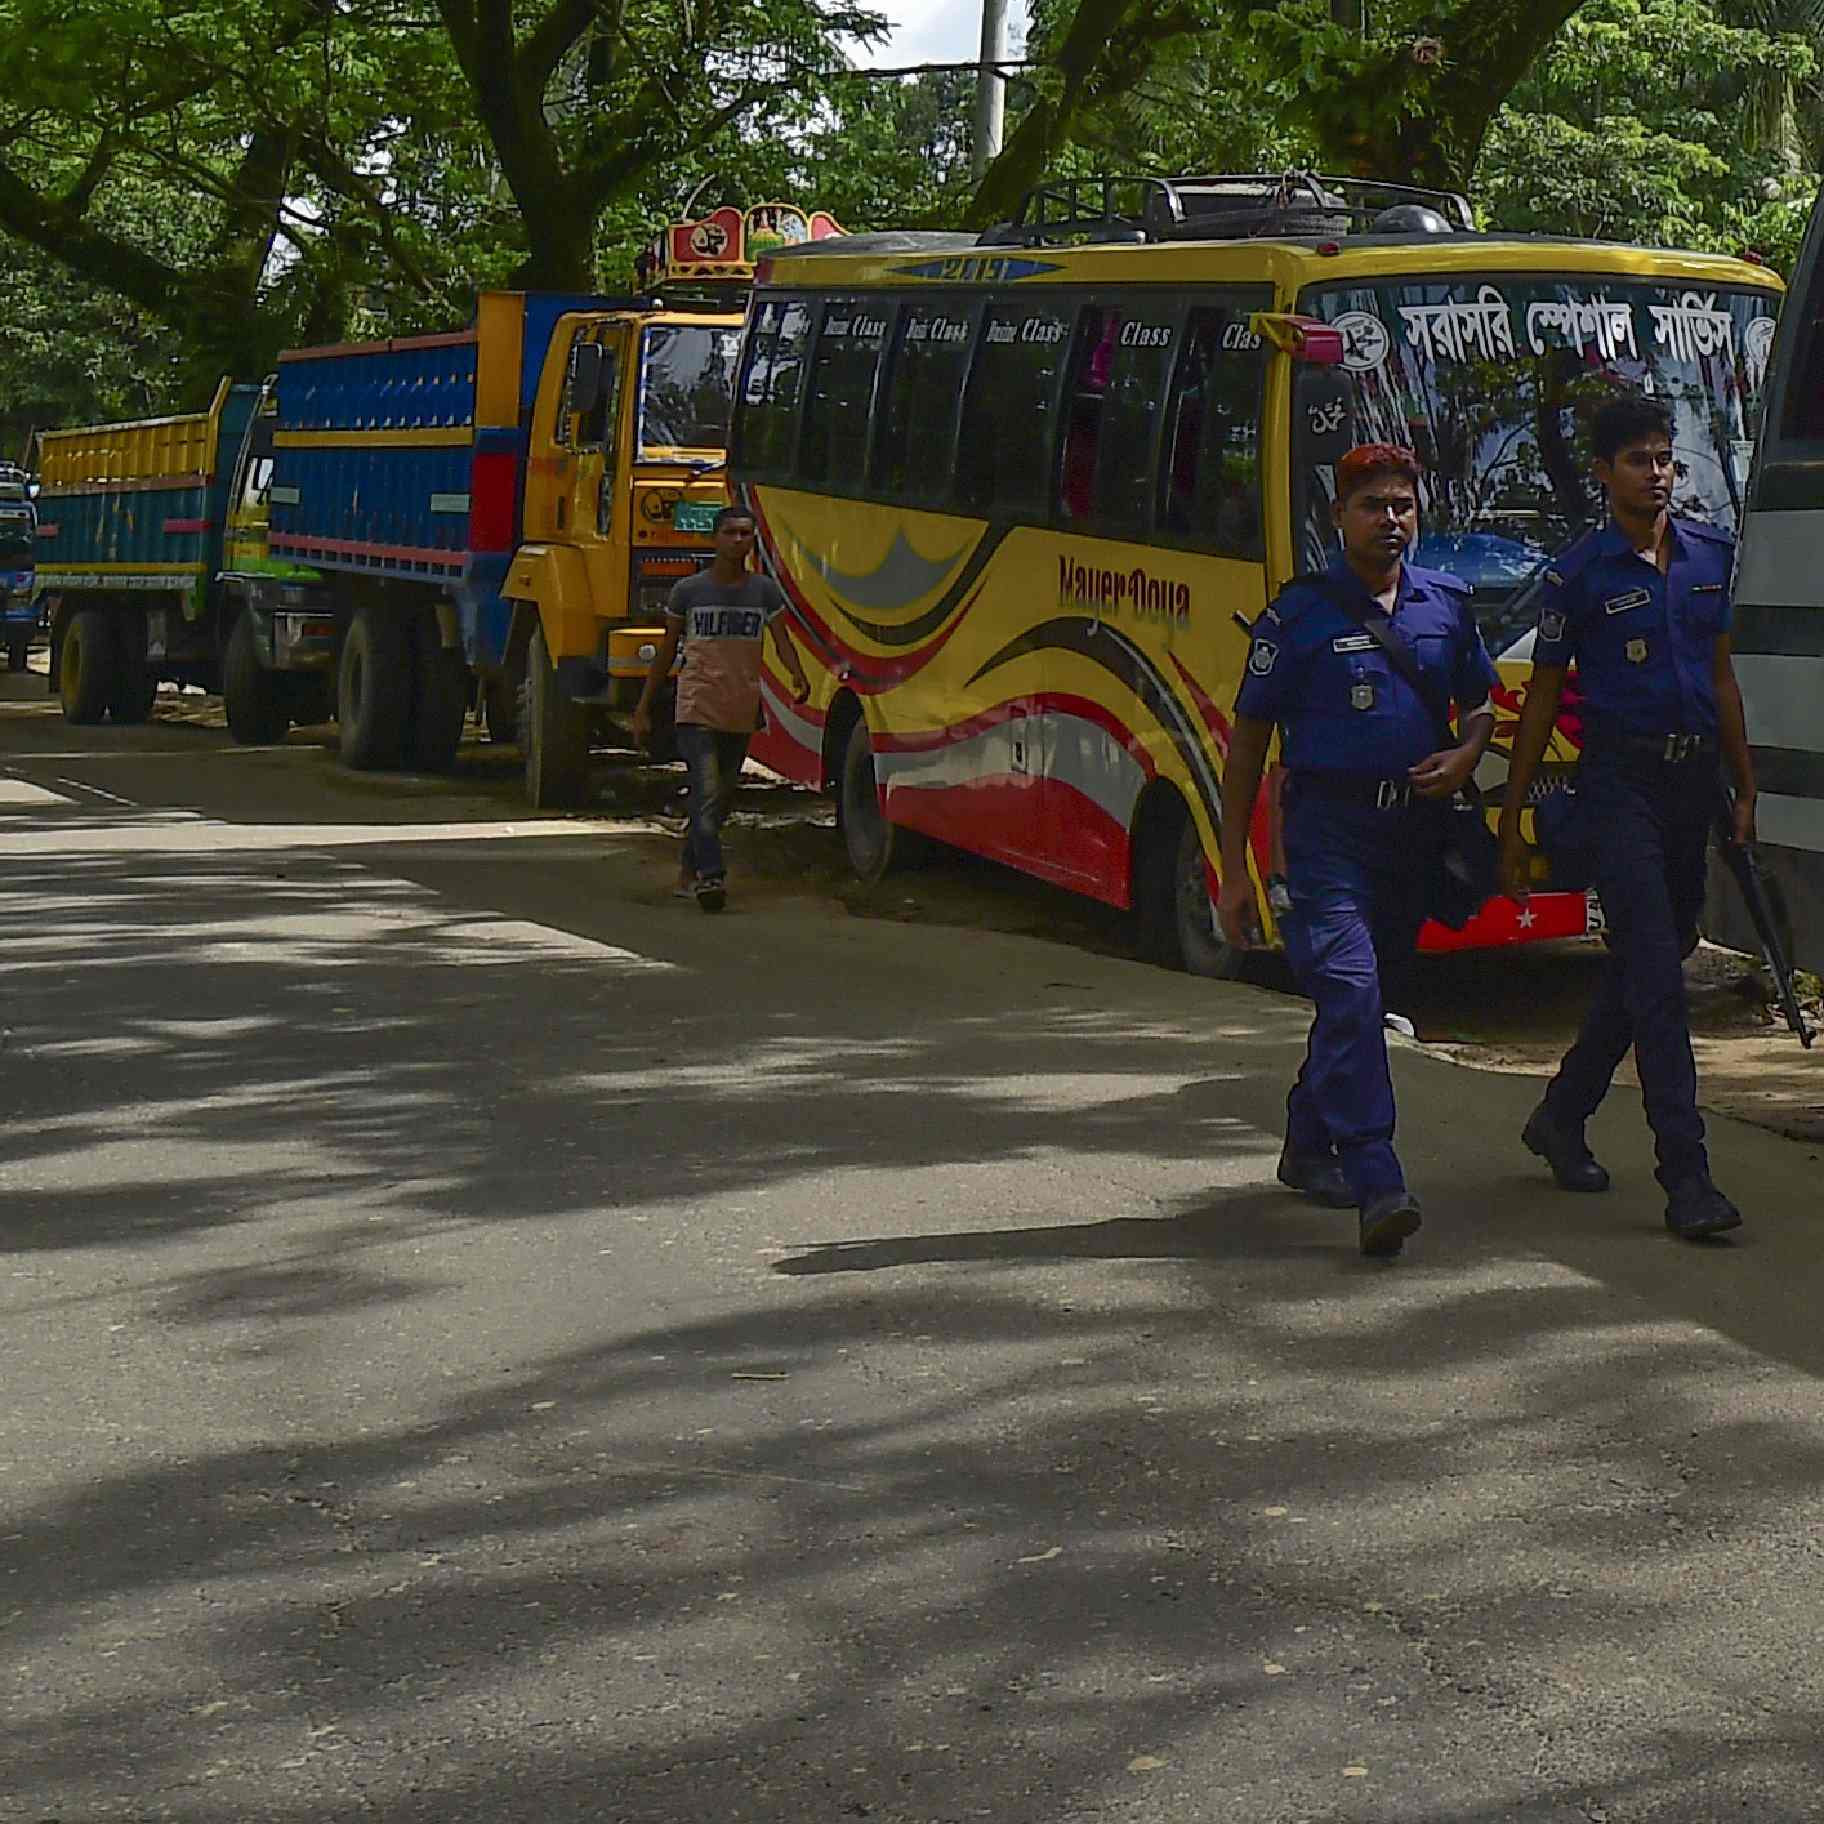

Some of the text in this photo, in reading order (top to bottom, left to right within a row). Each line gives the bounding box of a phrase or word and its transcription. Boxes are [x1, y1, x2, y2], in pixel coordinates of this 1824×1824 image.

[1119, 321, 1173, 347] Class
[1397, 285, 1516, 365] সরাসরি
[1528, 291, 1638, 361] স্পেশাল
[1646, 291, 1736, 367] সার্ভিস
